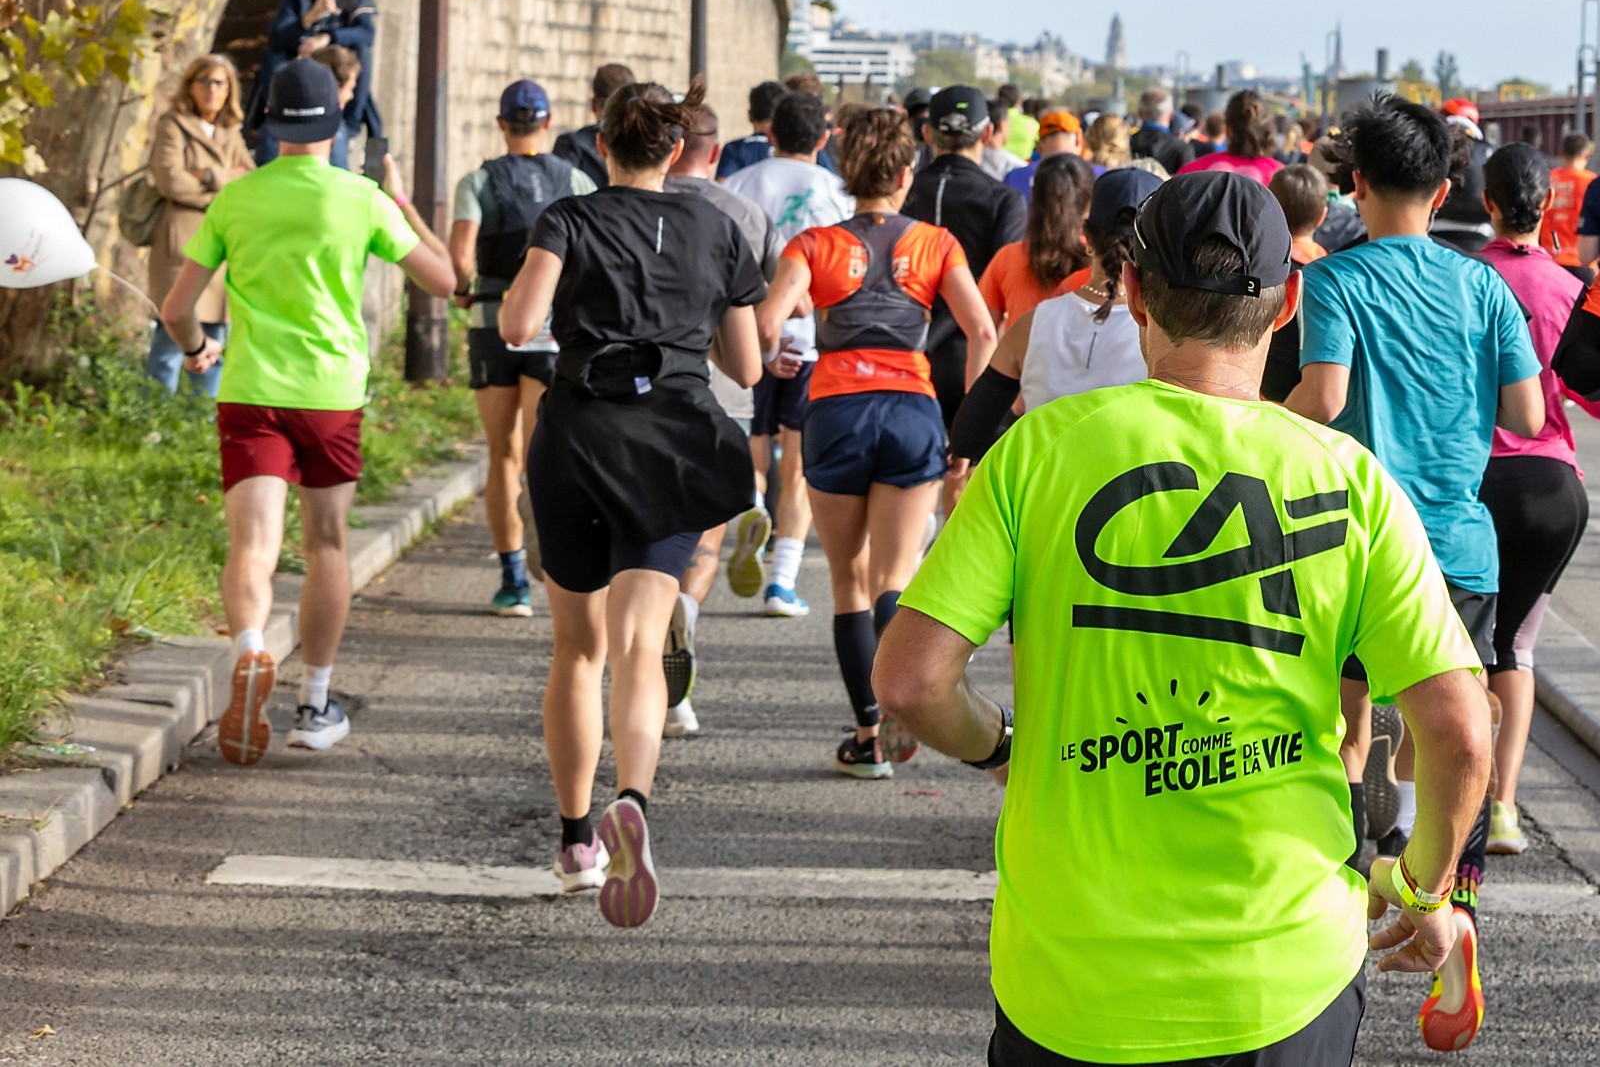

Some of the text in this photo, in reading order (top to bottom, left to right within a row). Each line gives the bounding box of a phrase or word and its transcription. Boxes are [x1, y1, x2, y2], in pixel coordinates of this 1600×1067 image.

[1061, 722, 1303, 773] LE SPORT COMME DE VIE
[1145, 748, 1261, 797] ÉCOLE LA
